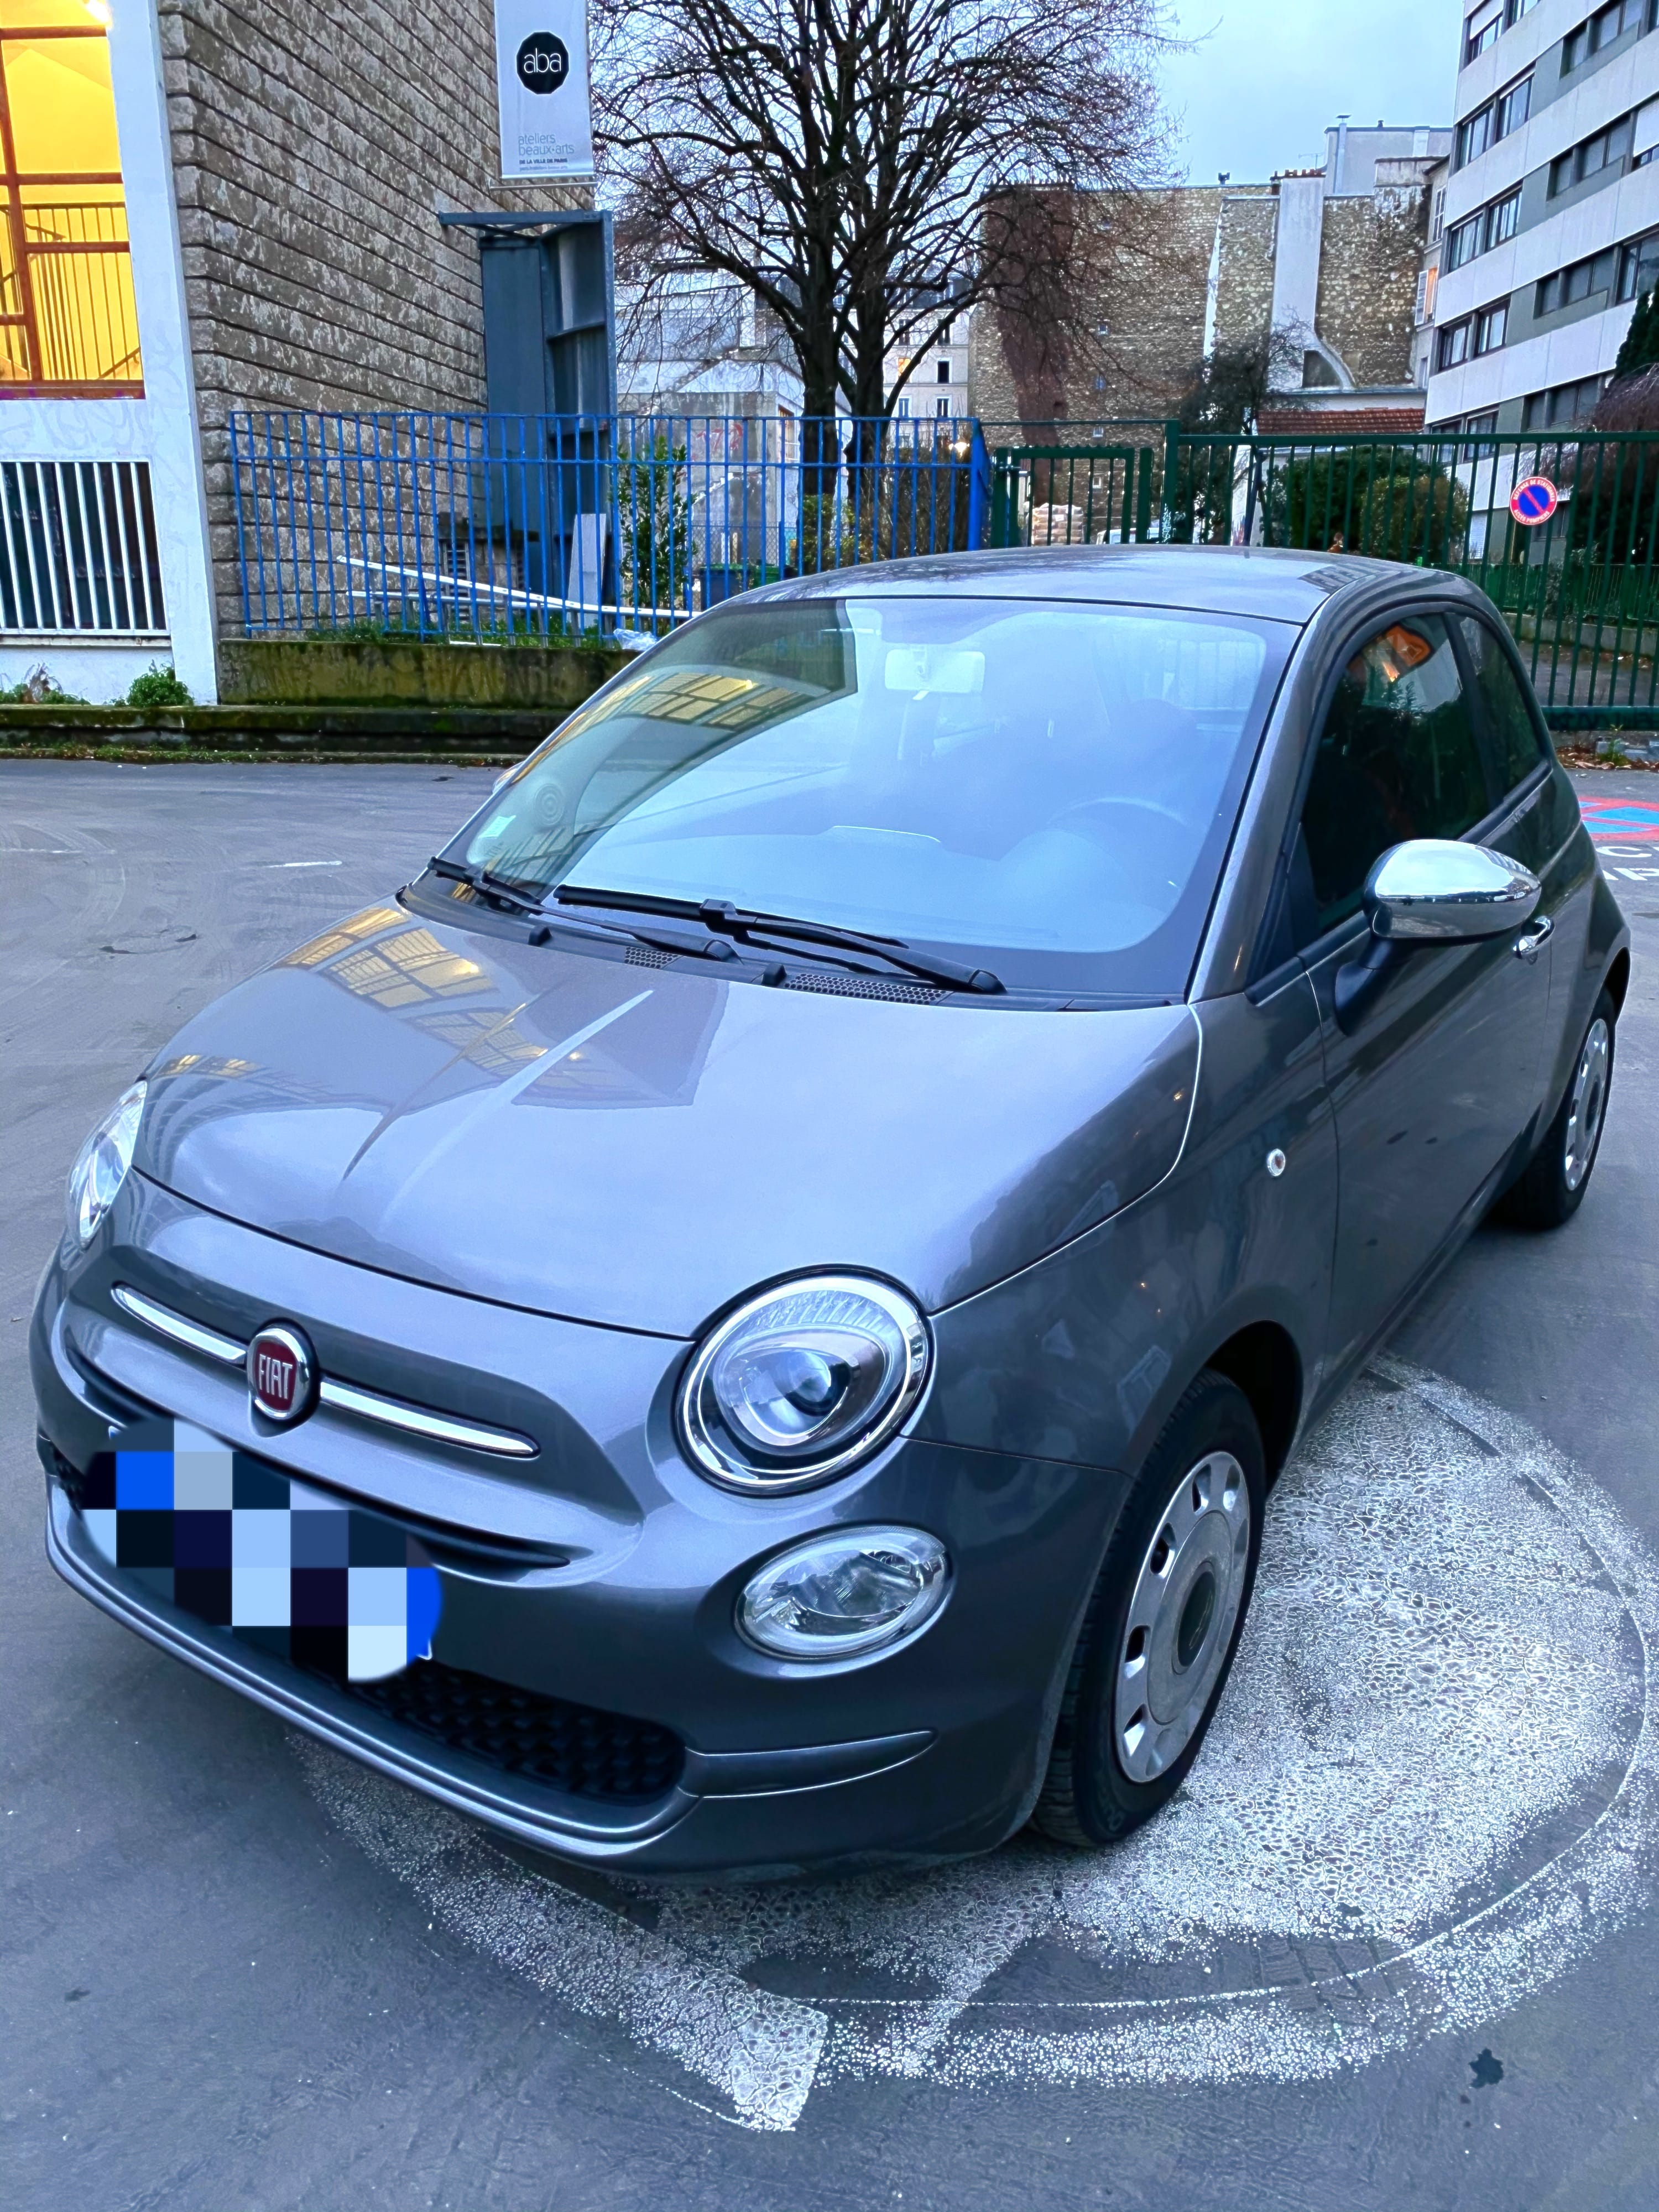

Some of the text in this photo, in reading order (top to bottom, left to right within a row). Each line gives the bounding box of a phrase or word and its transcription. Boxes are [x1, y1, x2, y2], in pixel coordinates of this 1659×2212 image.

[524, 48, 561, 73] aba
[518, 133, 556, 144] ateliers
[259, 1354, 293, 1400] FIAT
